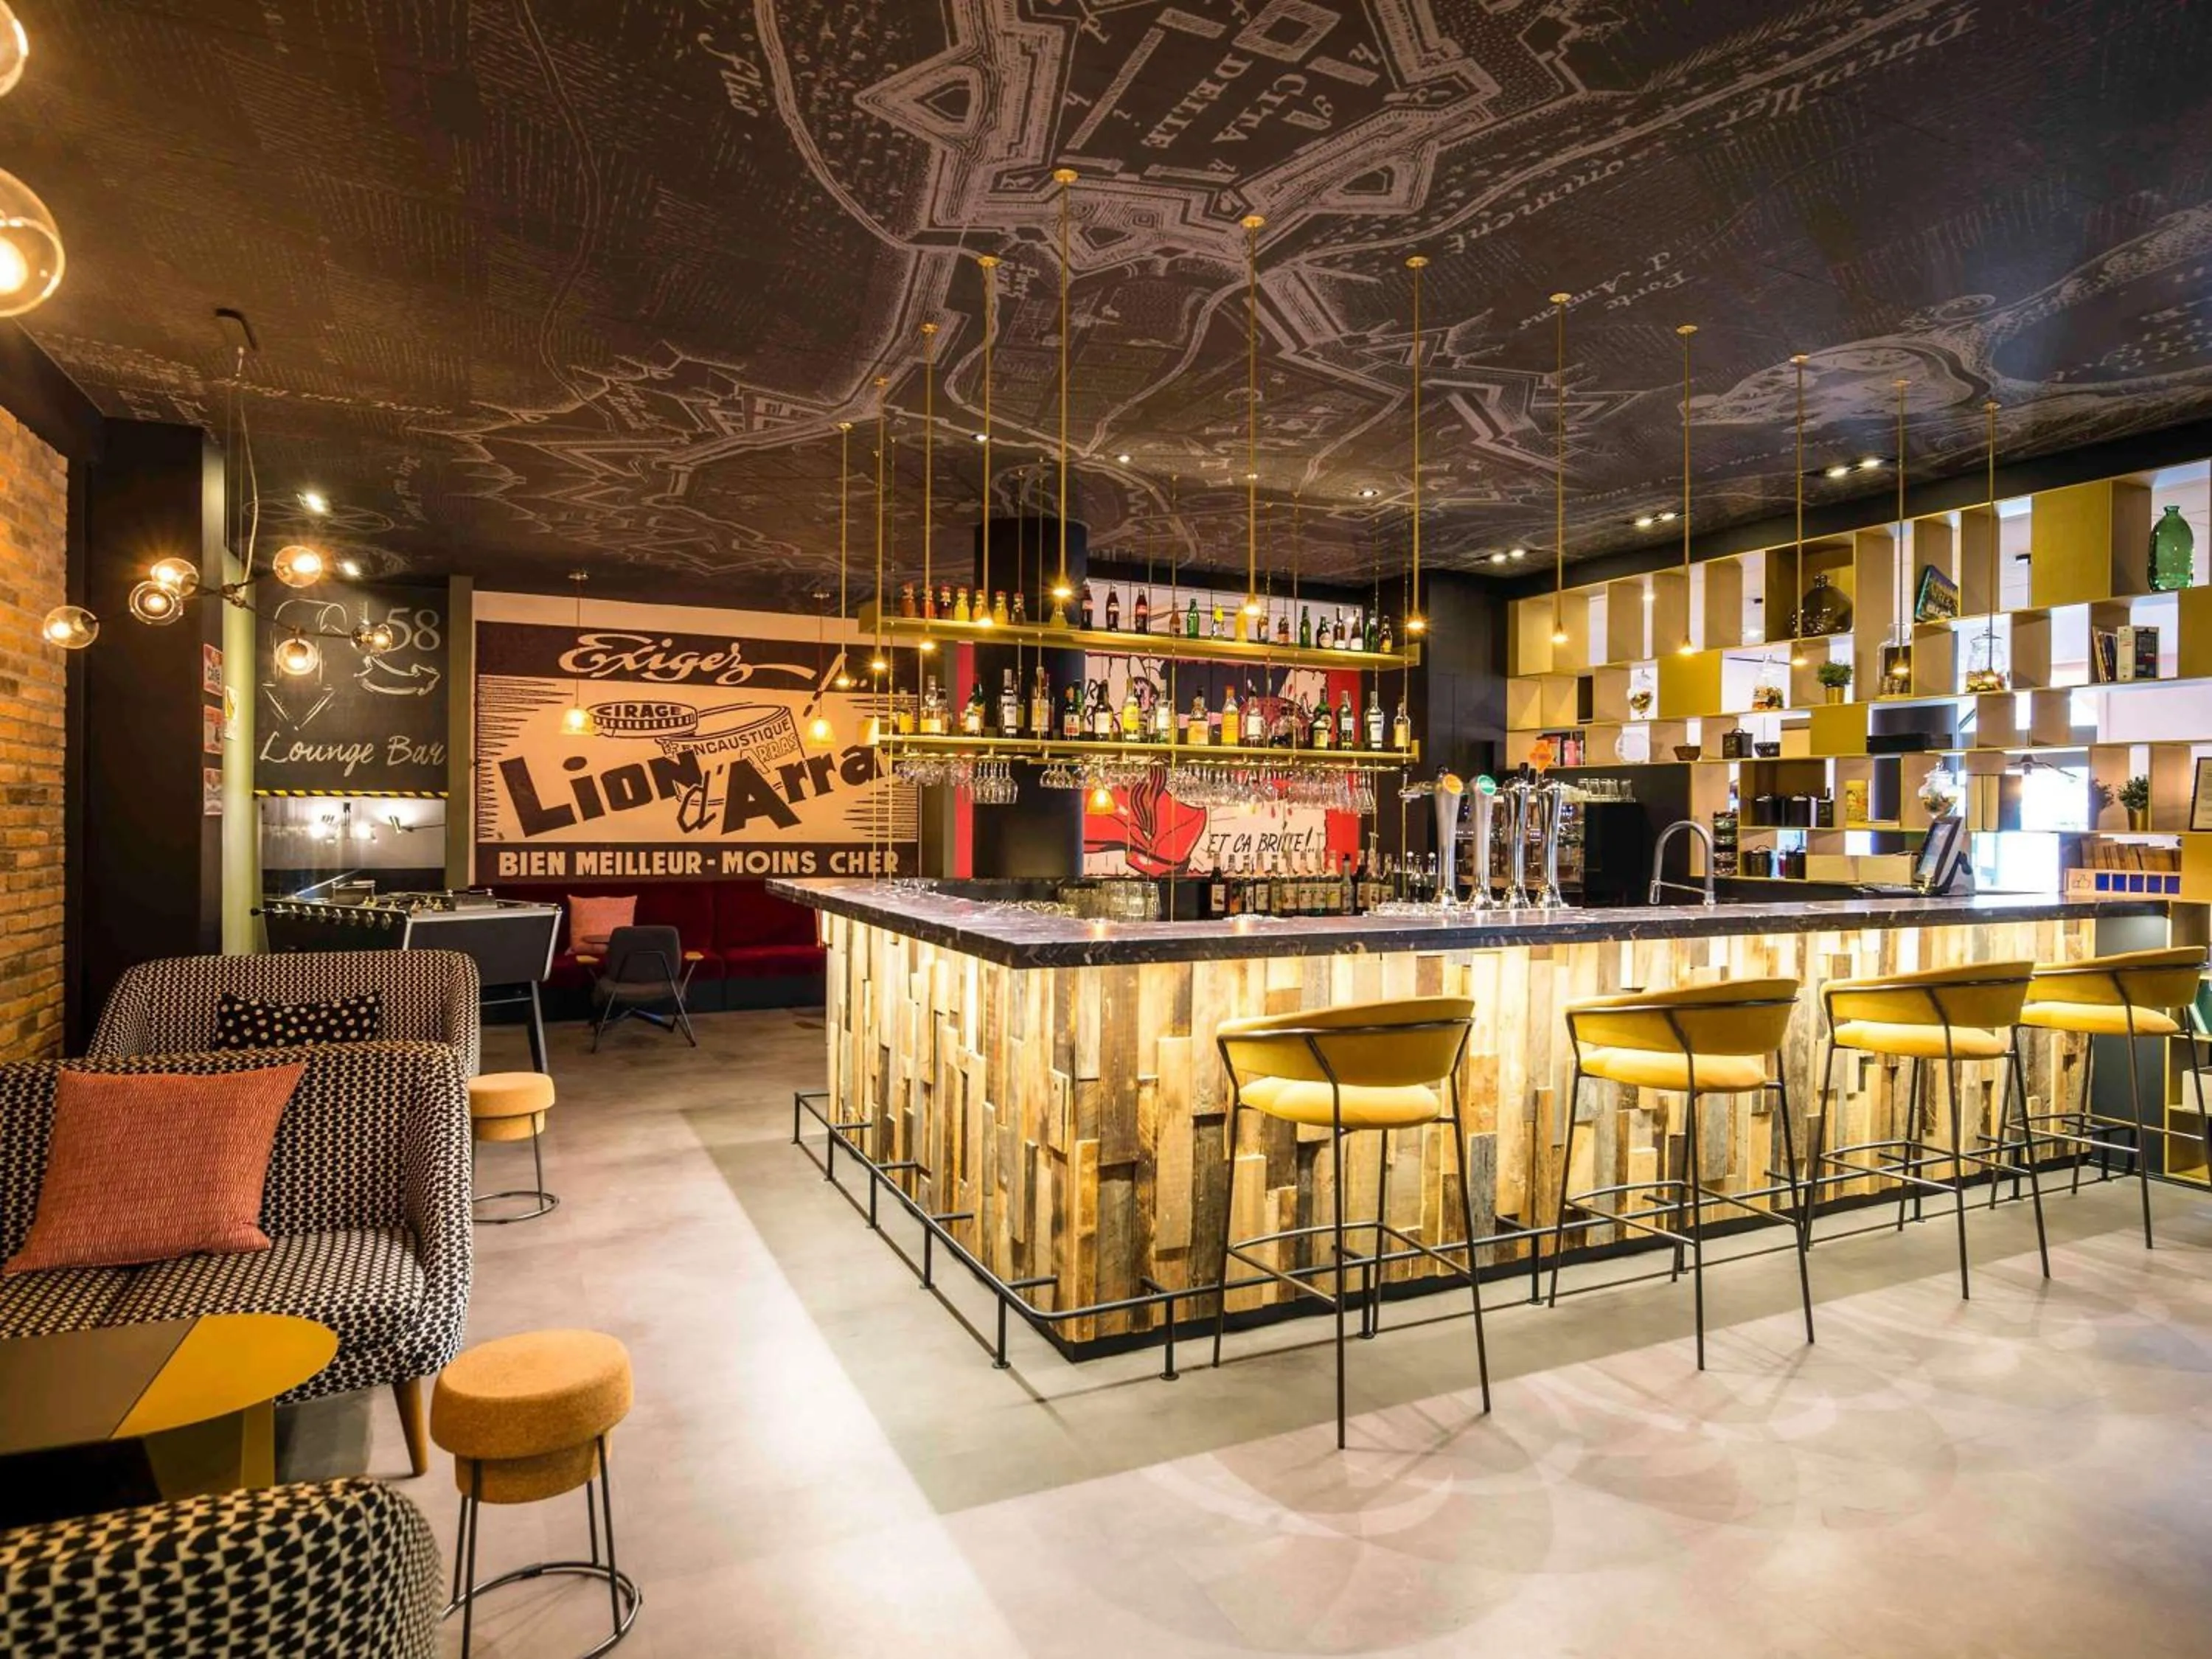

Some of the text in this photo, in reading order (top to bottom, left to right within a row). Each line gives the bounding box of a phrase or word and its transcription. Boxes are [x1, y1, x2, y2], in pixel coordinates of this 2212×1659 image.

[383, 607, 441, 653] 58
[596, 703, 684, 719] CIRAGE
[259, 731, 448, 777] Lounge Bar
[681, 718, 791, 756] ENCAUSTIQUE
[676, 745, 887, 835] d'Arra
[1207, 832, 1232, 853] ET
[498, 851, 566, 877] BIEN
[575, 850, 703, 876] MEILLEUR
[721, 850, 818, 874] MOINS
[829, 850, 900, 874] CHER
